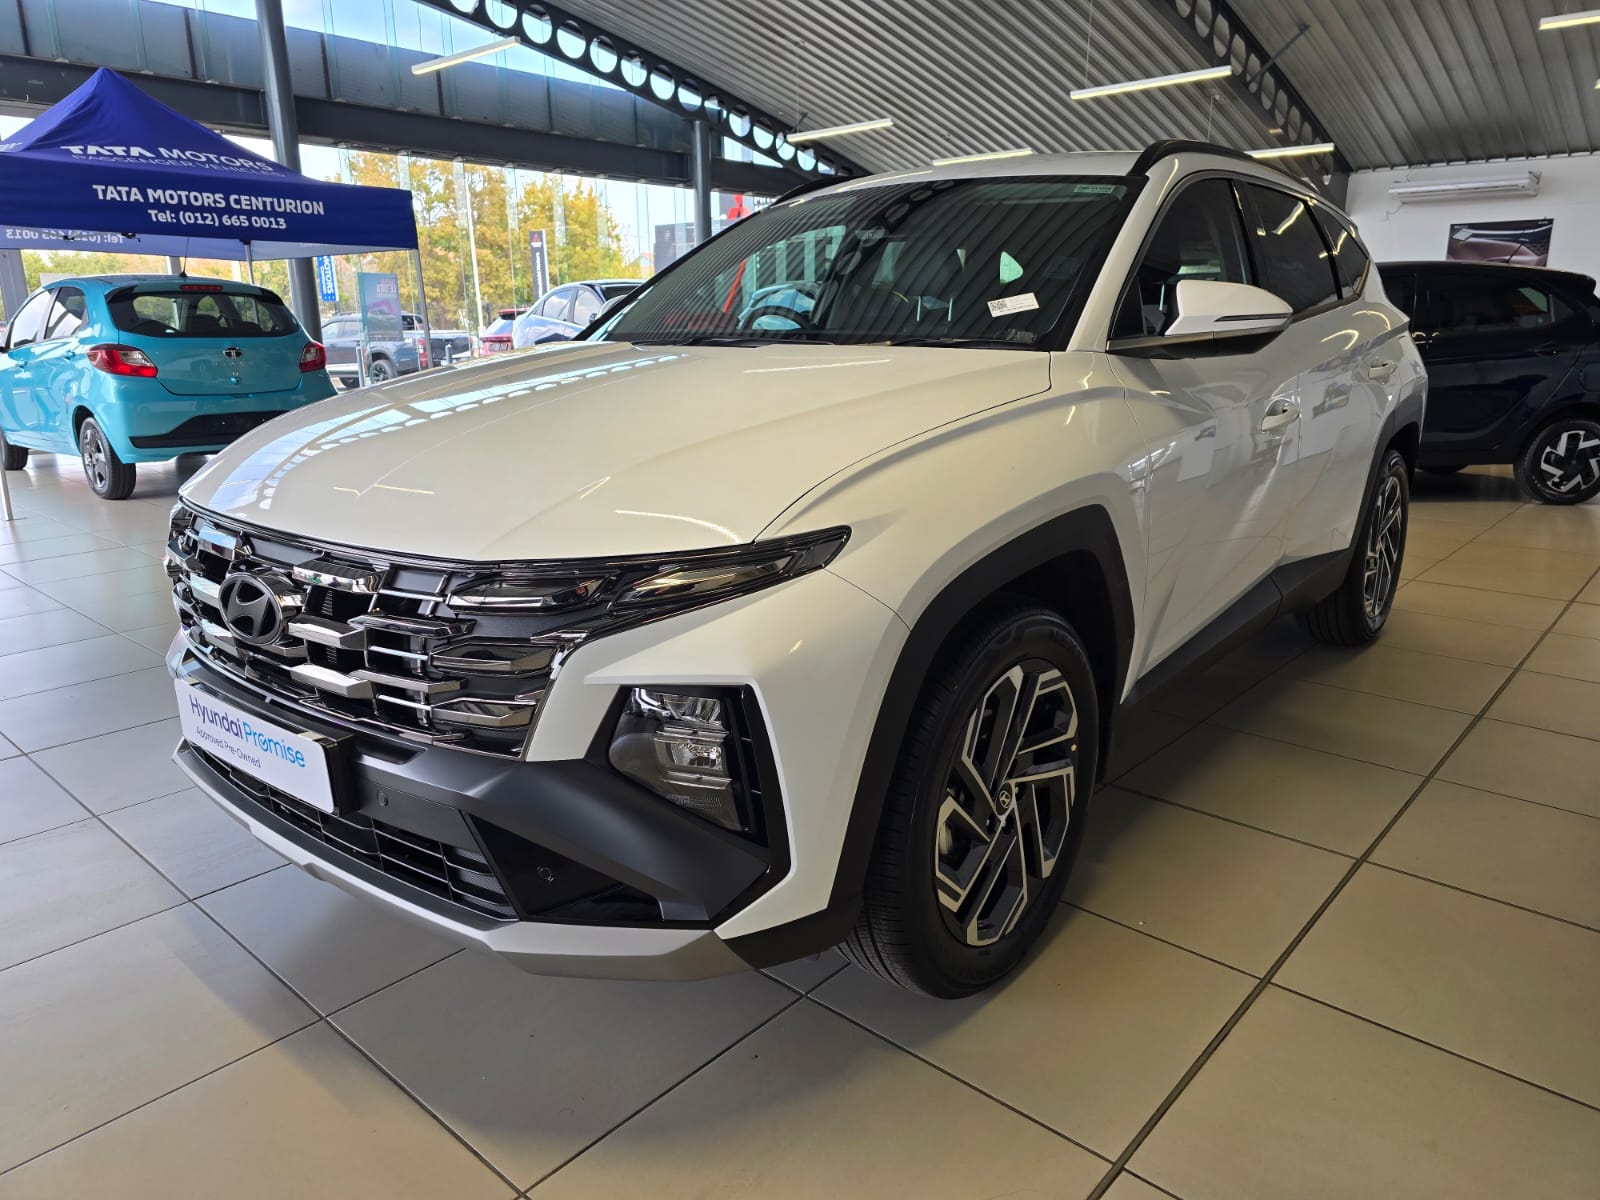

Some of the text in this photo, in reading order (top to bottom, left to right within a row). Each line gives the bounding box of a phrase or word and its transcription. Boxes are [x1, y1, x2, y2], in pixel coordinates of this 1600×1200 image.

[60, 145, 274, 172] TATA MOTORS
[92, 184, 325, 215] TATA MOTORS CENTURION
[147, 209, 287, 230] Tel: (012) 665 0013
[190, 695, 305, 768] Hyundai Promise
